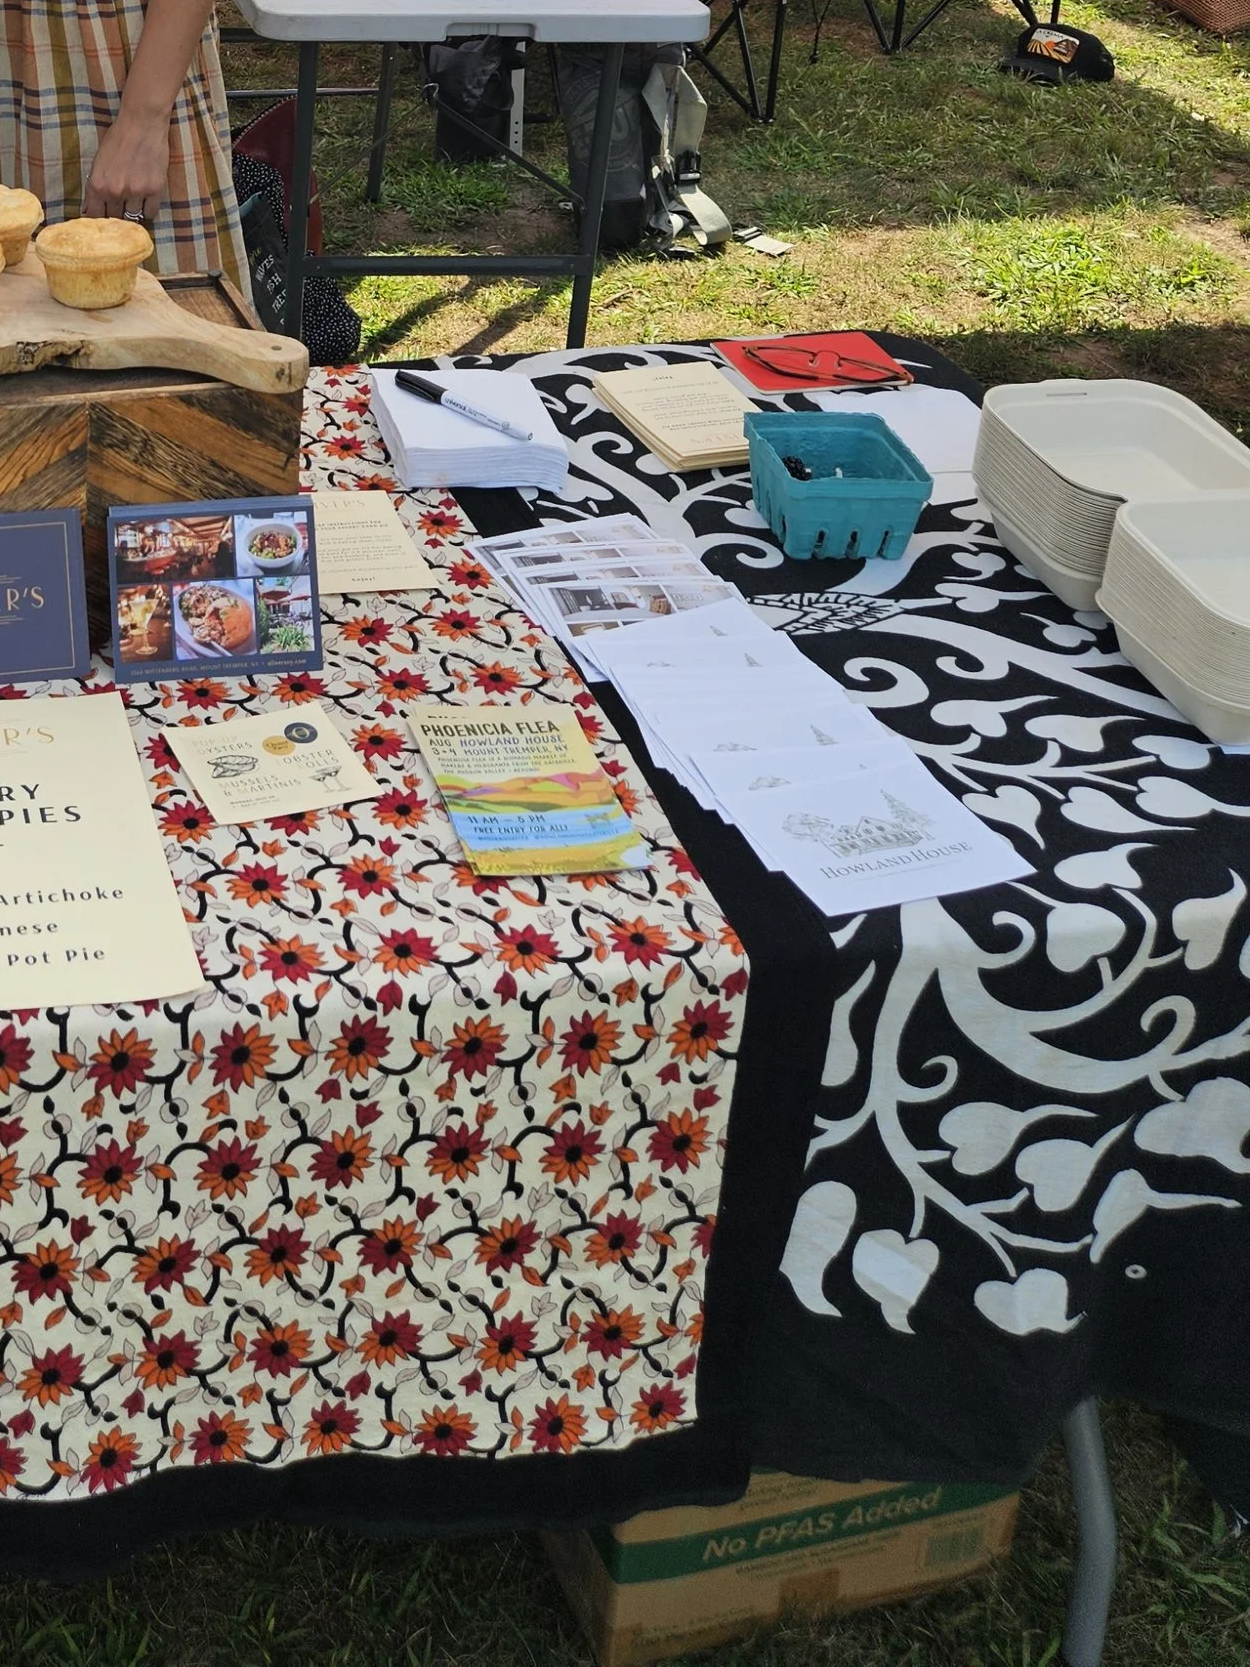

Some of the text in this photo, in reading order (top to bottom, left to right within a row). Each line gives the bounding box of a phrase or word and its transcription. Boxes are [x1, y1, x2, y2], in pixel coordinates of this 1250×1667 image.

[421, 721, 560, 737] PHOENICIA FLEA
[429, 734, 565, 747] AUG HOWLAND HOUSE
[198, 742, 252, 755] OYSTERS
[464, 747, 500, 756] MOUNT
[555, 743, 569, 752] NY
[219, 774, 280, 789] MUSSELS
[238, 778, 302, 795] MARTINIS
[498, 826, 526, 834] ENTRY
[820, 855, 912, 879] HOWLAND
[911, 842, 973, 861] HOUSE
[7, 951, 51, 966] Pot
[66, 948, 106, 962] Pie
[701, 1537, 746, 1563] No
[755, 1512, 834, 1549] PFAS
[843, 1486, 943, 1530] Added
